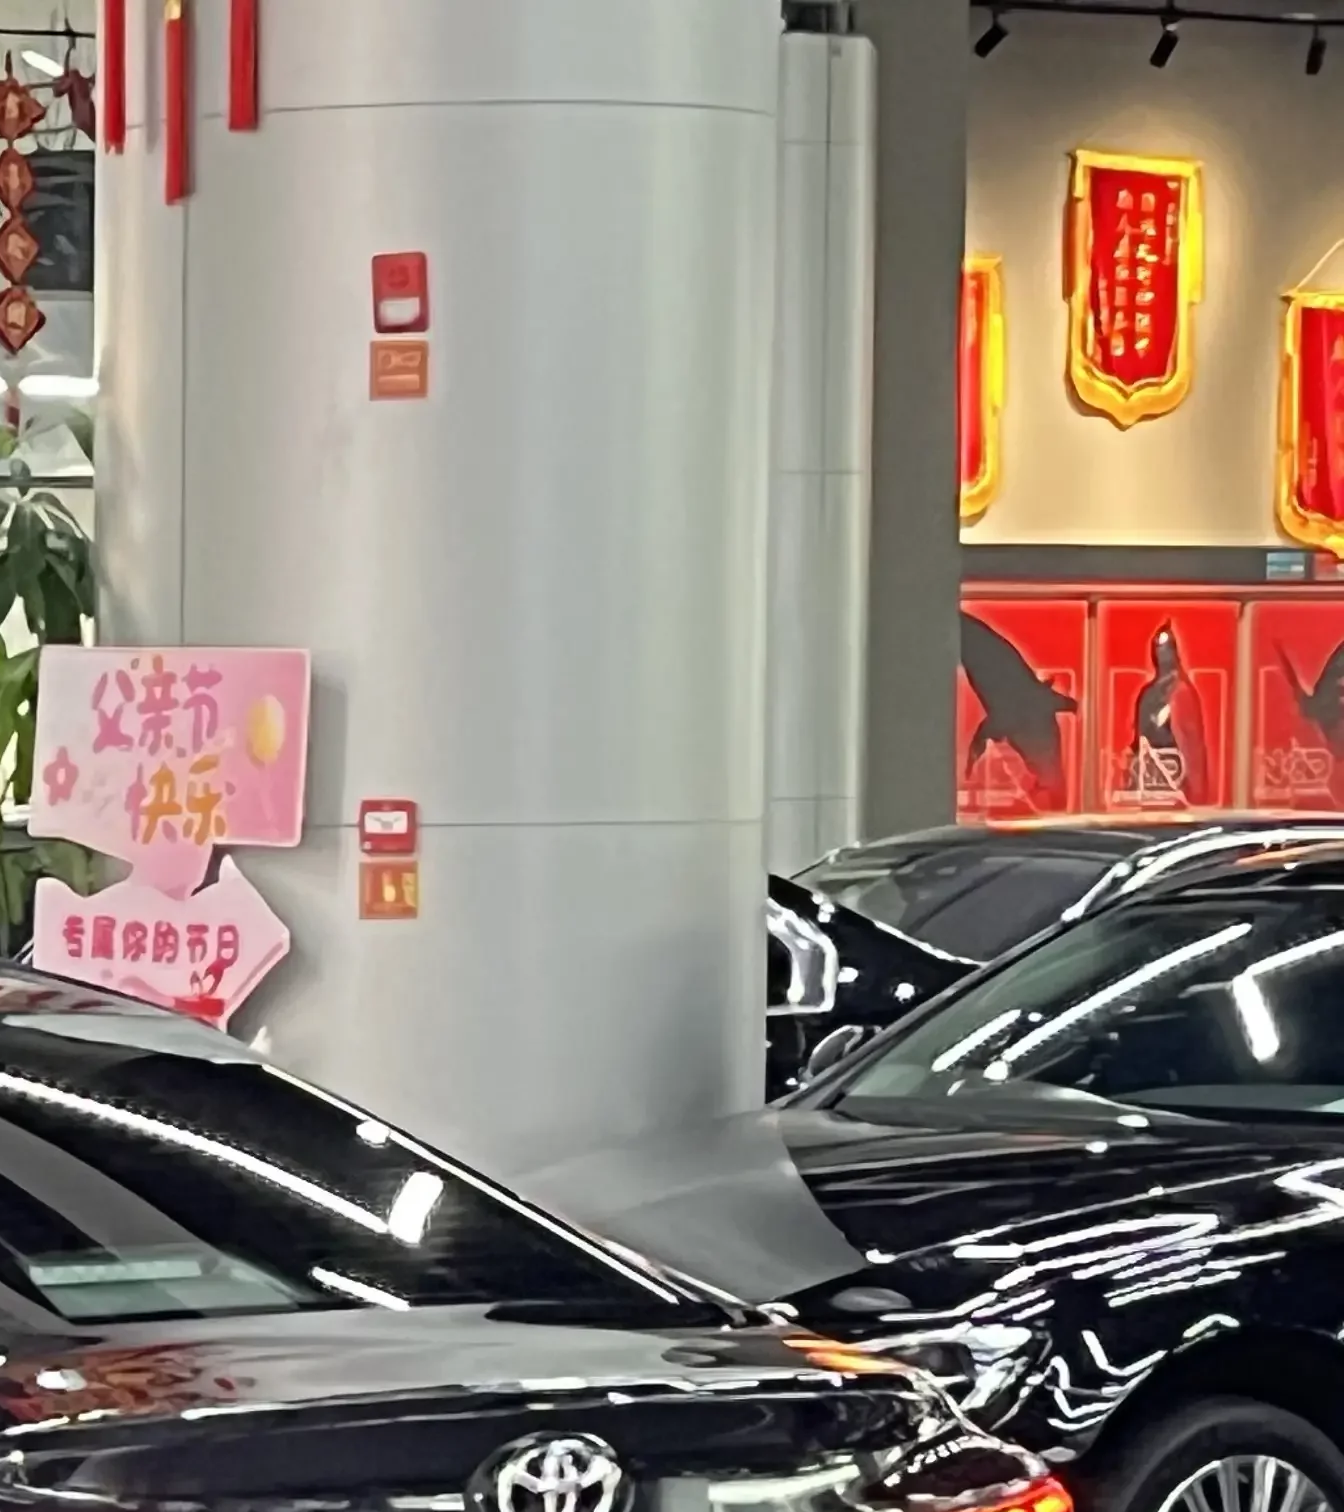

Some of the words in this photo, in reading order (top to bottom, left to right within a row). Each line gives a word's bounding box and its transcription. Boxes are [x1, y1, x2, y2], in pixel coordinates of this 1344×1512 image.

[92, 654, 223, 756] 父亲节
[125, 754, 226, 845] 快乐
[63, 915, 240, 964] 专属你的节日
